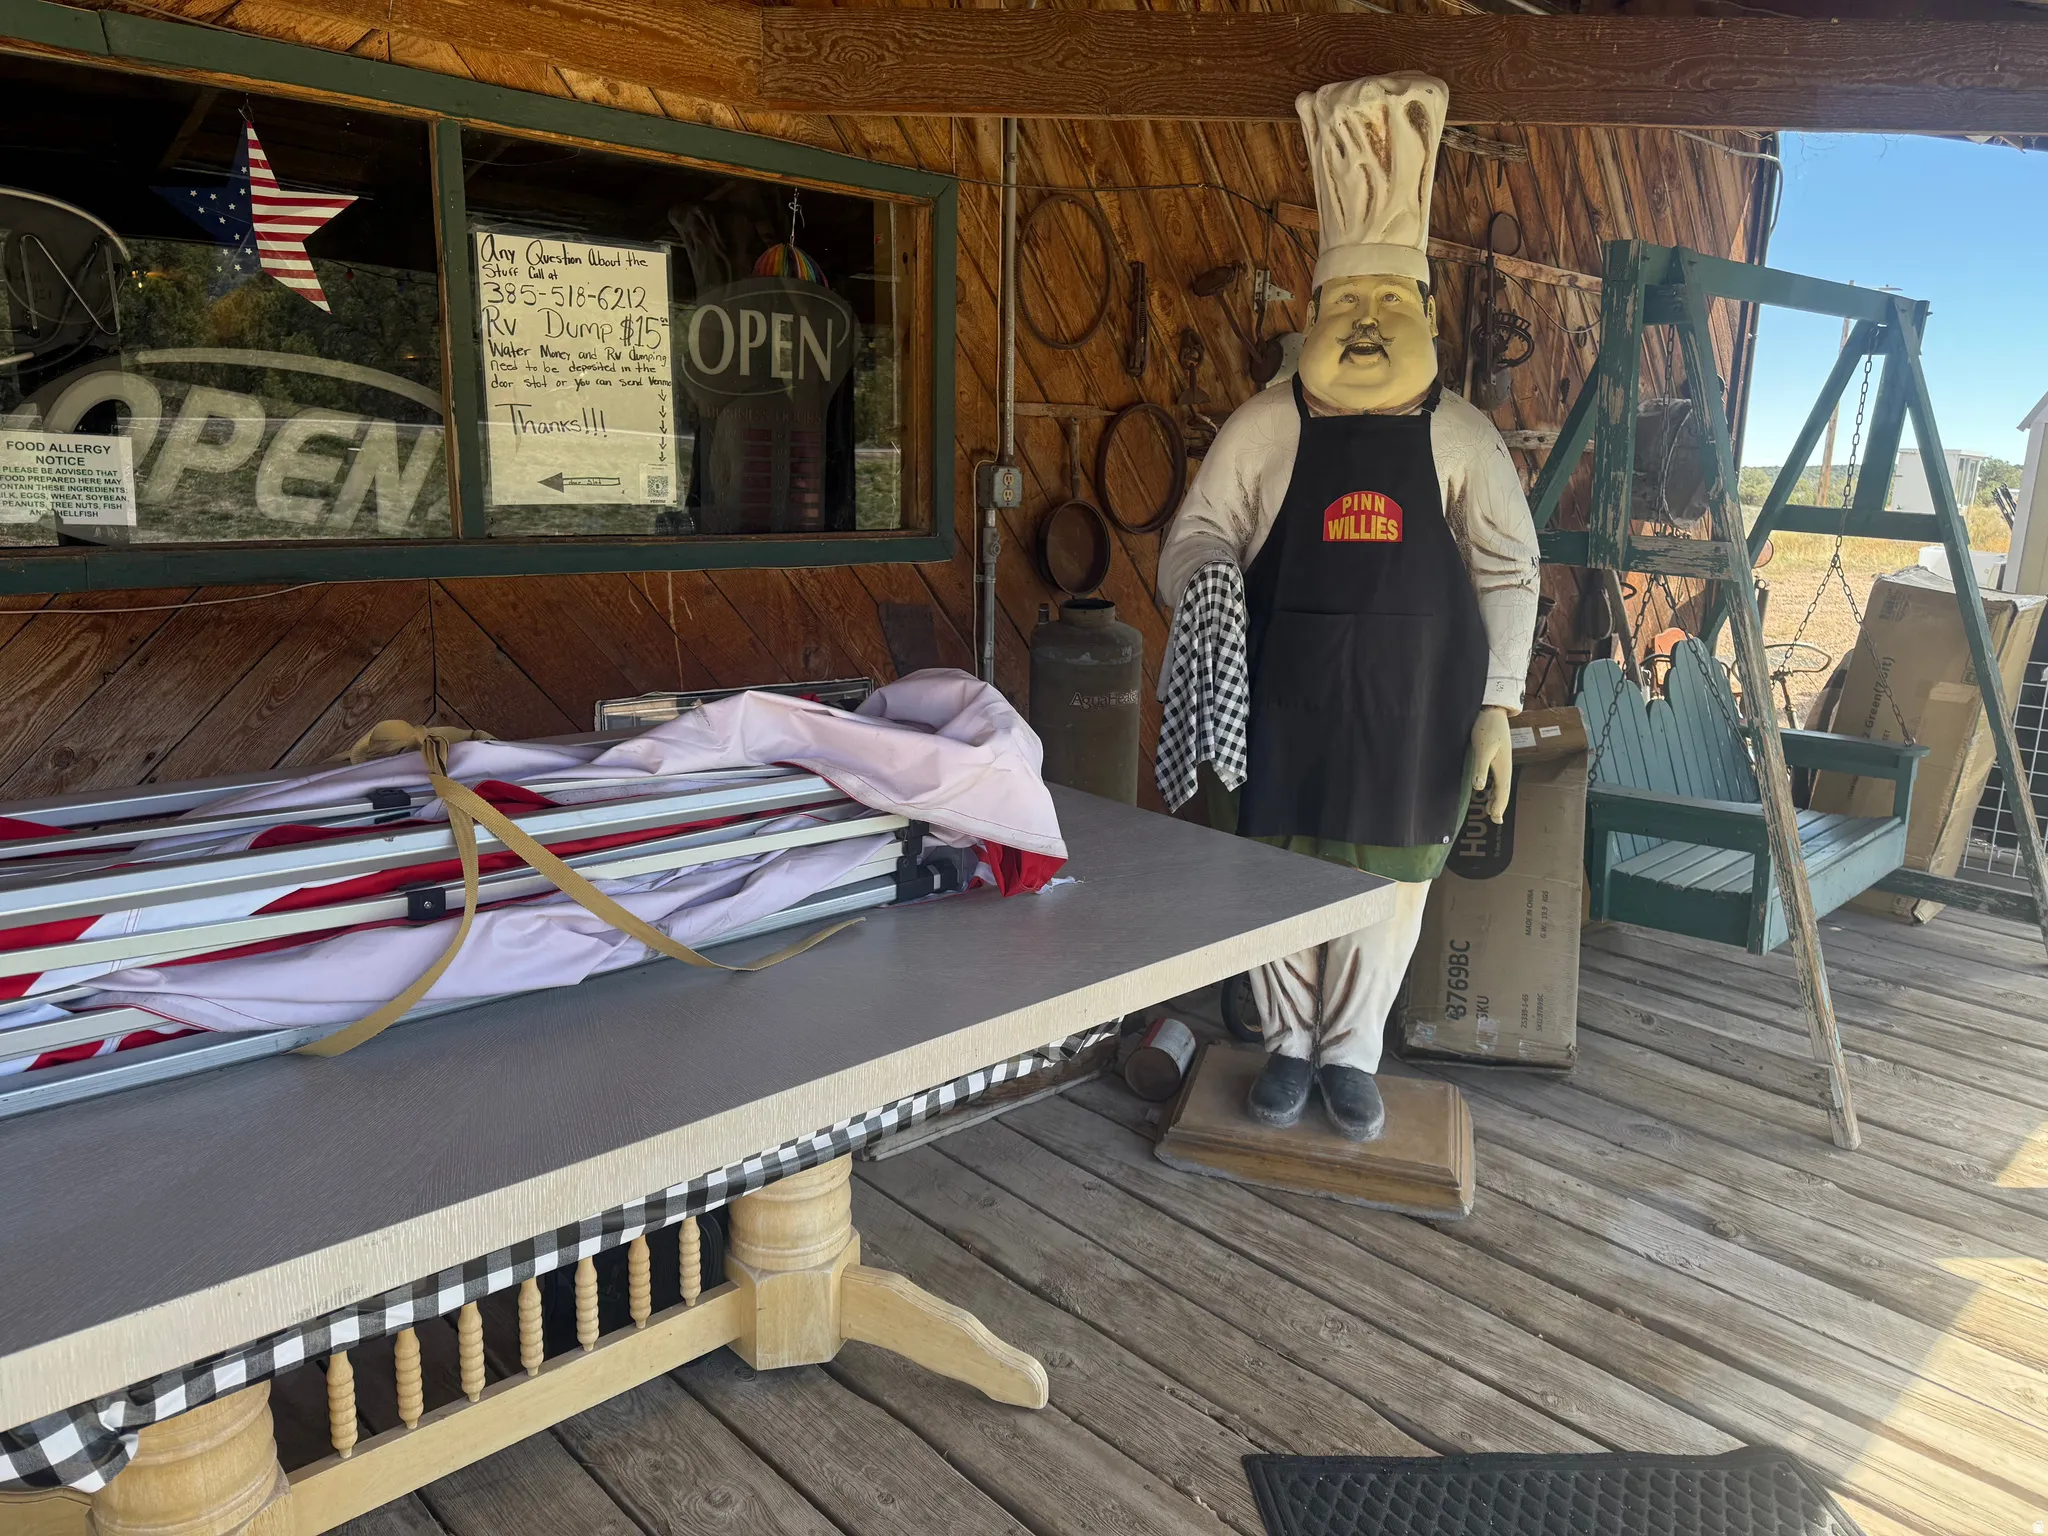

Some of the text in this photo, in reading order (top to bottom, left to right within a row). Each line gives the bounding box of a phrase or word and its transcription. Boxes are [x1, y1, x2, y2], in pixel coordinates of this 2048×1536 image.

[481, 234, 649, 267] Any Question About the
[482, 263, 558, 280] Stuff Call at
[483, 282, 649, 312] 385-518-6212
[537, 308, 613, 343] Dump
[688, 304, 833, 382] OPEN
[488, 339, 531, 359] Water
[540, 344, 571, 361] Money
[578, 348, 598, 360] and
[629, 346, 667, 367] dumping
[490, 360, 518, 371] need
[525, 360, 538, 372] to
[543, 361, 559, 373] be
[569, 361, 616, 373] deposited
[635, 362, 657, 373] the
[491, 373, 514, 389] door
[595, 379, 612, 387] can
[618, 376, 644, 387] send
[495, 403, 608, 438] Thanks!!!
[6, 441, 111, 455] FOOD ALLERGY
[43, 370, 443, 534] OPEN
[35, 455, 86, 466] NOTICE
[2, 466, 118, 477] PLEASE BE ADVISED THAT
[27, 475, 76, 484] PREPARED
[78, 477, 102, 485] HERE
[0, 483, 128, 494] ONTAIN THESE INGREDIENTS:
[51, 501, 74, 509] TREE
[58, 509, 99, 518] HELLFISH
[1342, 494, 1385, 514] PINN
[1328, 515, 1399, 541] WILLIES
[1526, 889, 1534, 908] CHINA
[1525, 917, 1533, 936] MADE
[1445, 939, 1471, 1020] 8769BC
[1475, 995, 1490, 1021] SKU
